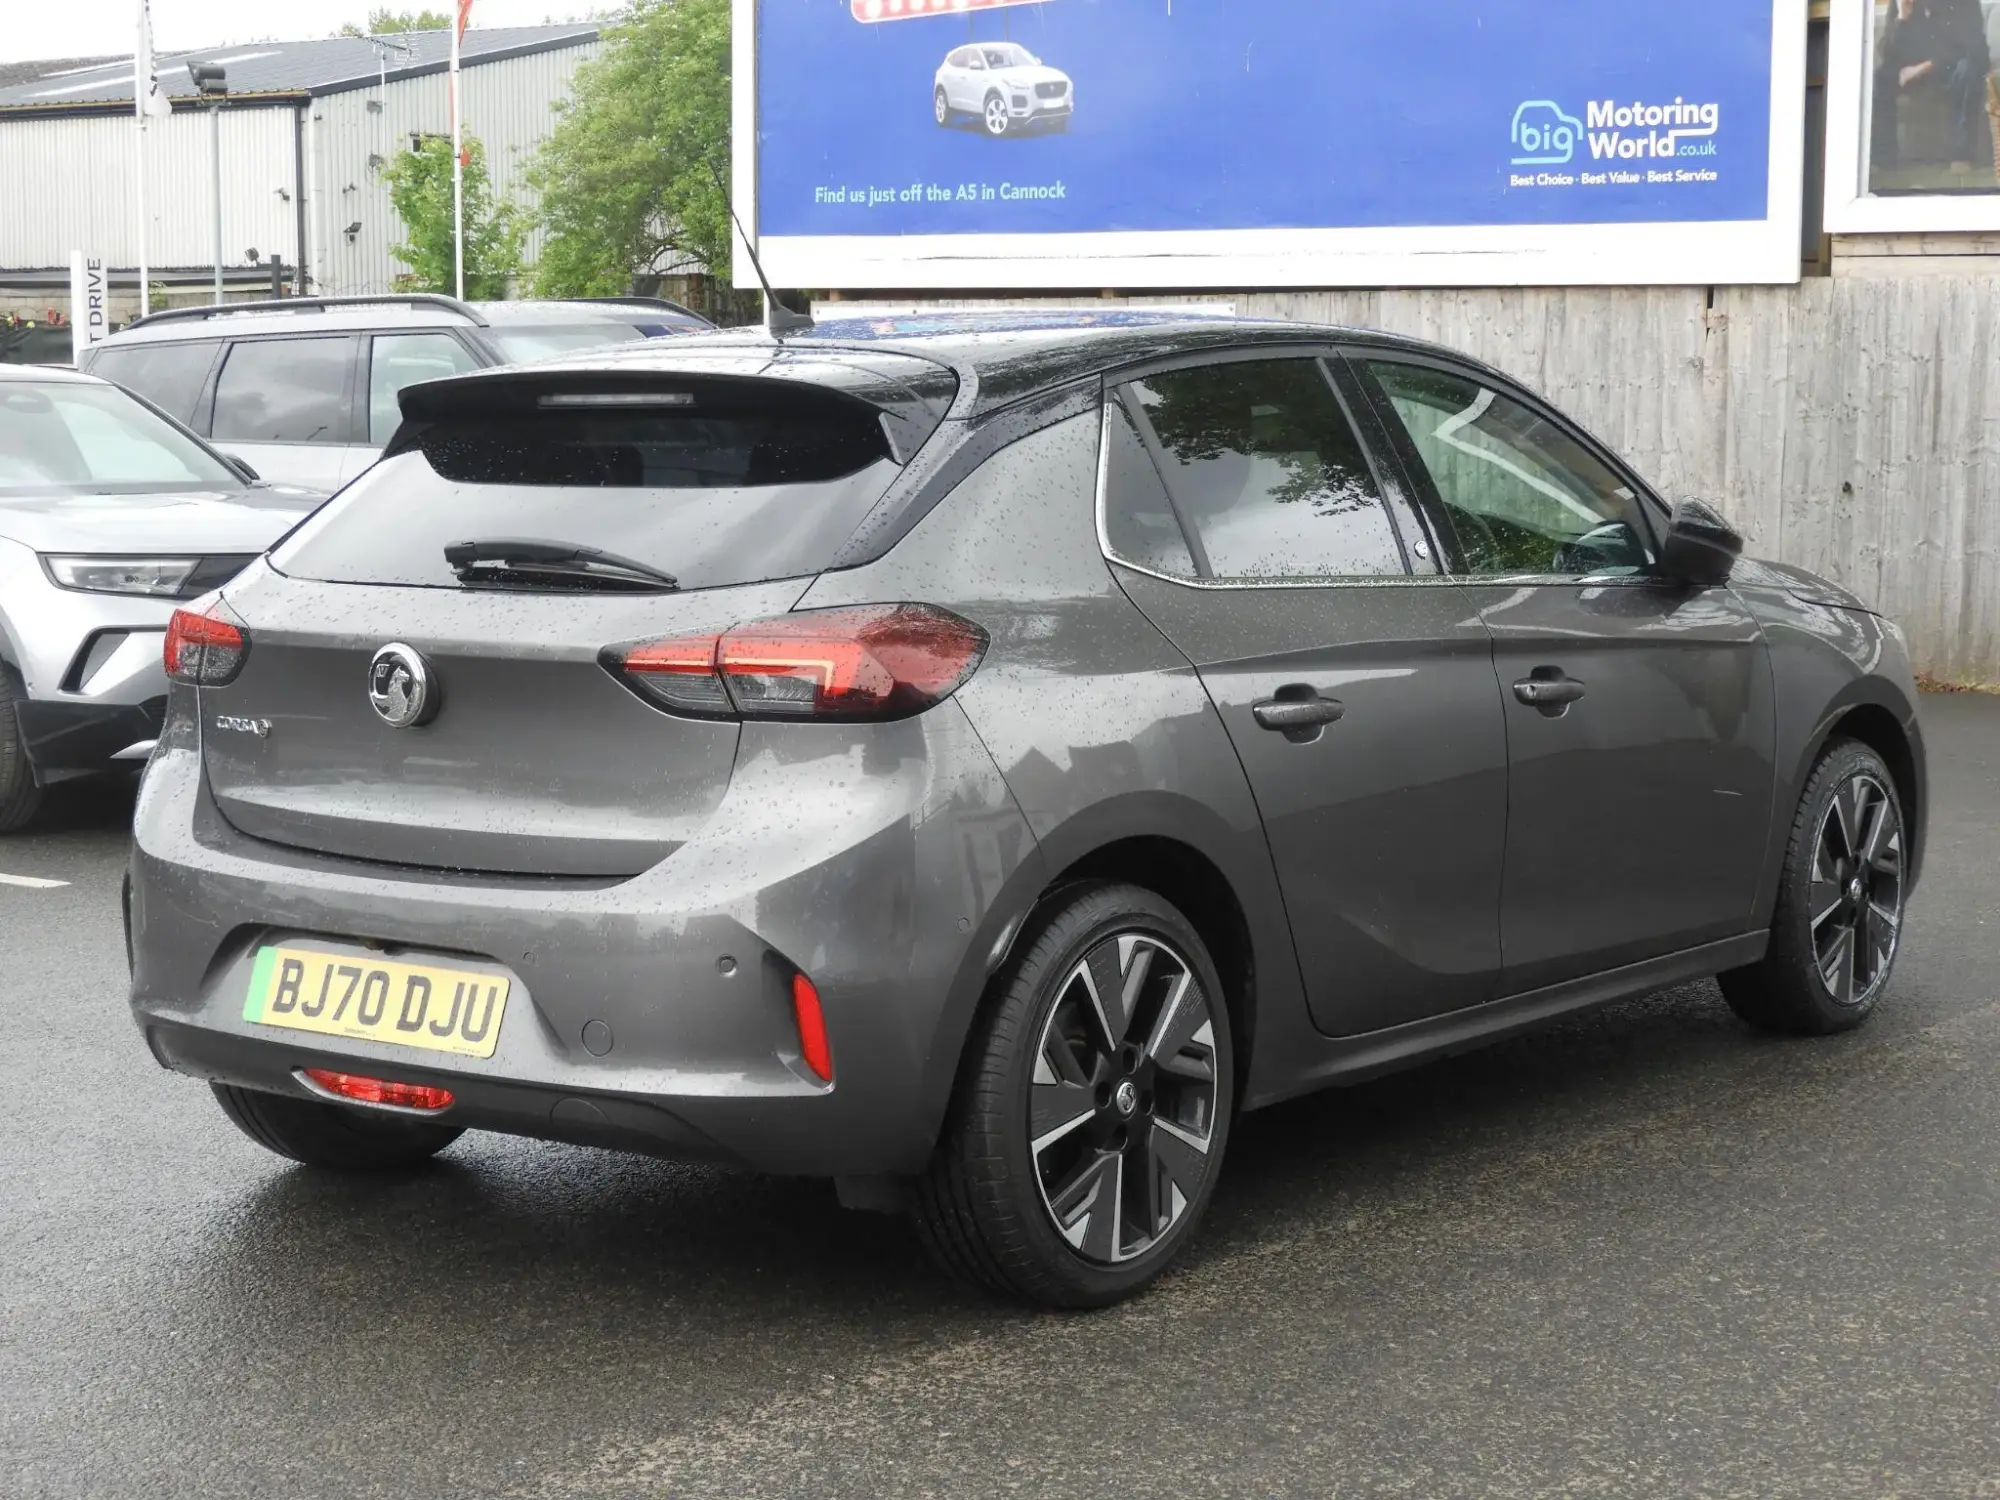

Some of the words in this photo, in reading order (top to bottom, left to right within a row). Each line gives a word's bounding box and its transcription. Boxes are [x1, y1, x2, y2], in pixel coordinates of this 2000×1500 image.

[1587, 97, 1719, 136] Motoring
[1511, 122, 1574, 164] big
[815, 186, 846, 203] Find
[850, 190, 866, 203] us
[868, 186, 896, 207] just
[900, 184, 923, 202] off
[926, 185, 951, 201] the
[955, 184, 977, 201] A5
[981, 183, 996, 200] in
[999, 181, 1066, 200] Cannock
[1510, 174, 1535, 187] Best
[1536, 173, 1574, 186] Choice
[1581, 172, 1606, 185] Best
[1608, 170, 1640, 184] Value
[1647, 170, 1673, 183] Best
[1676, 168, 1718, 182] Service
[87, 257, 103, 327] DRIVE
[271, 957, 391, 1026] BJ70
[395, 974, 498, 1043] DJU
